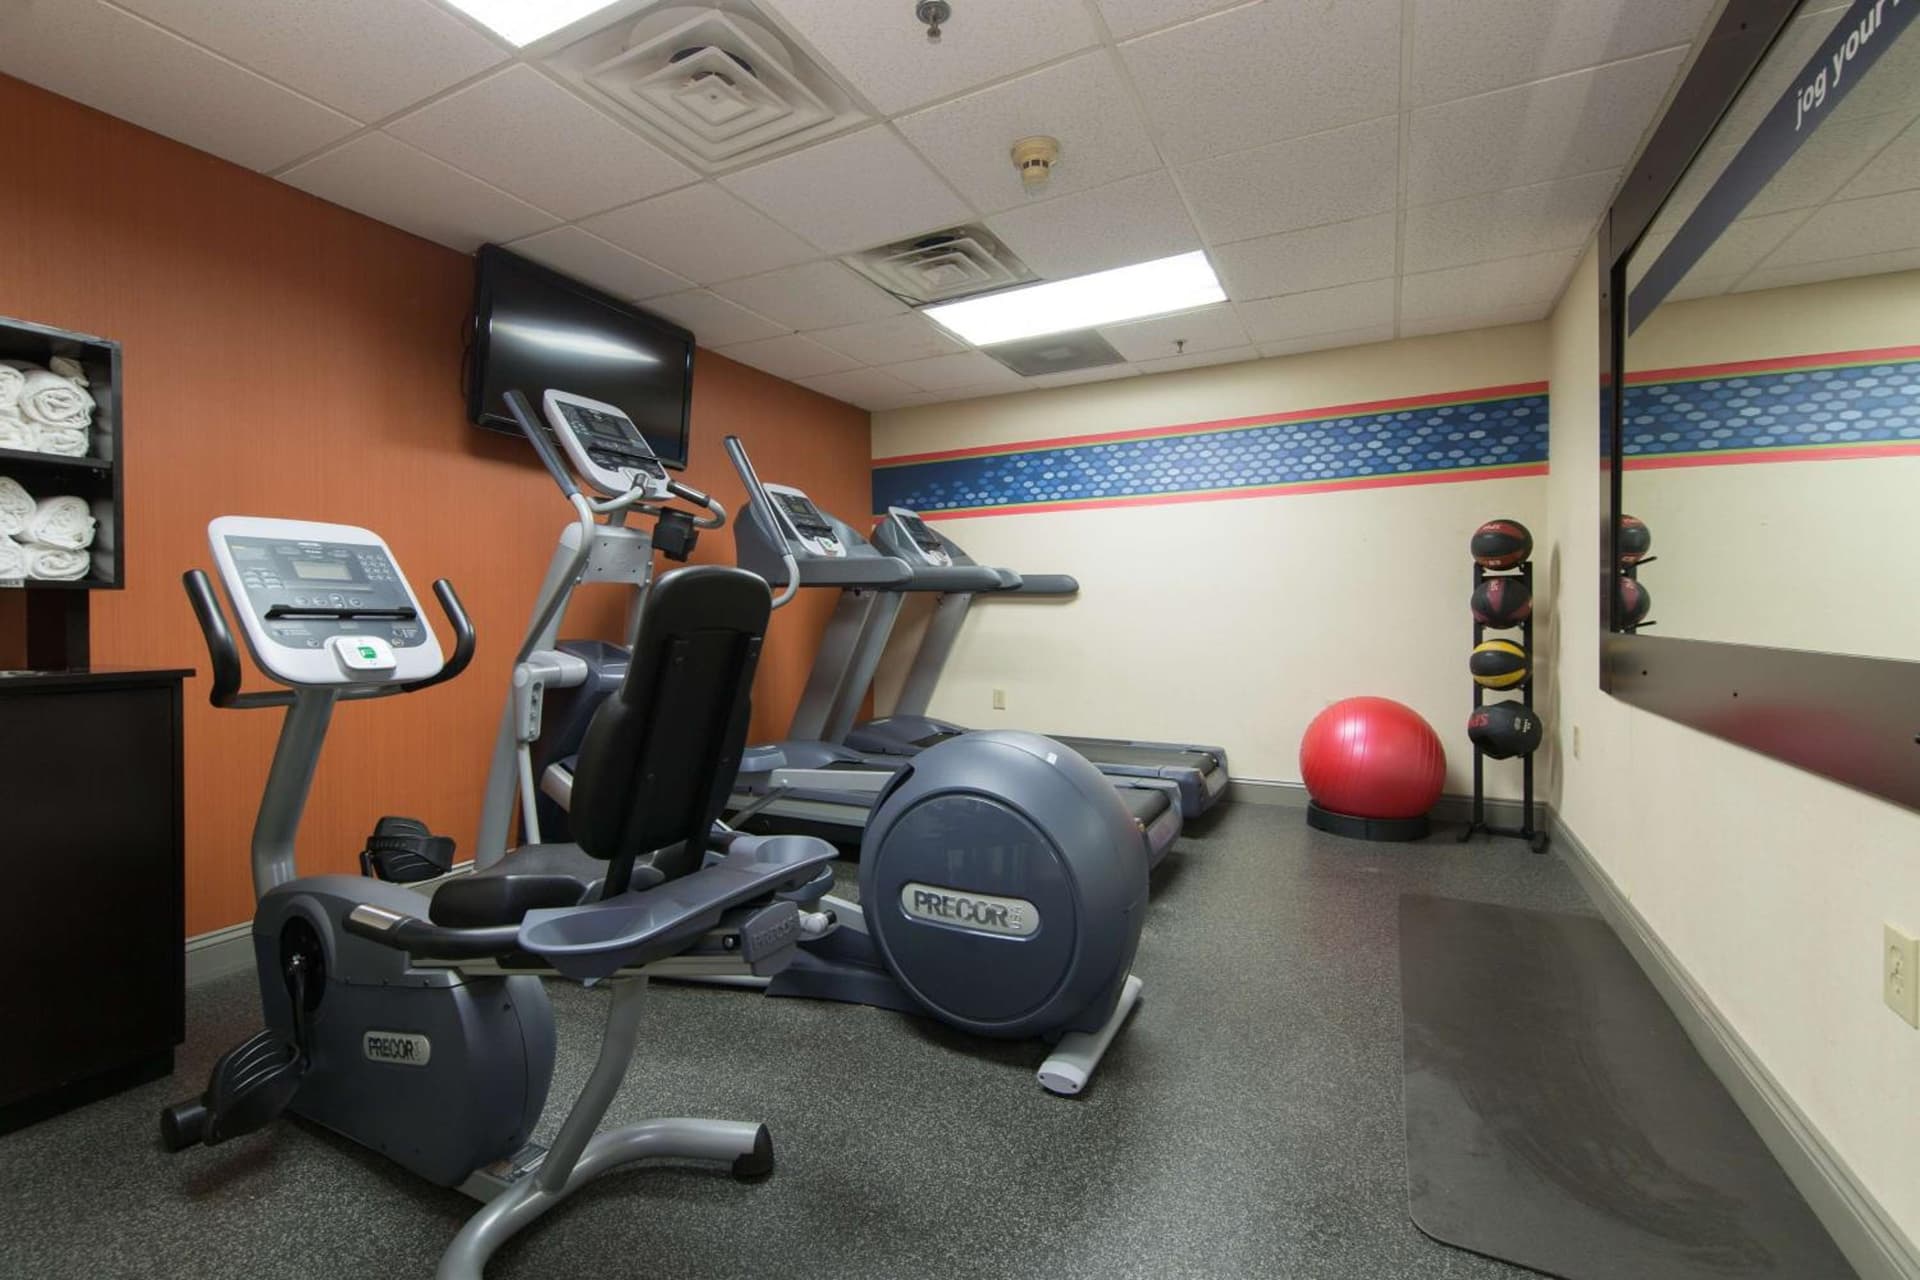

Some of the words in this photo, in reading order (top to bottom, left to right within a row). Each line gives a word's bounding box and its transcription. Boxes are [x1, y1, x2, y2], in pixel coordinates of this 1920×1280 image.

[1794, 67, 1827, 131] jog
[1832, 0, 1886, 88] your
[913, 890, 1009, 928] PRECOR
[367, 1036, 415, 1061] PRECOR
